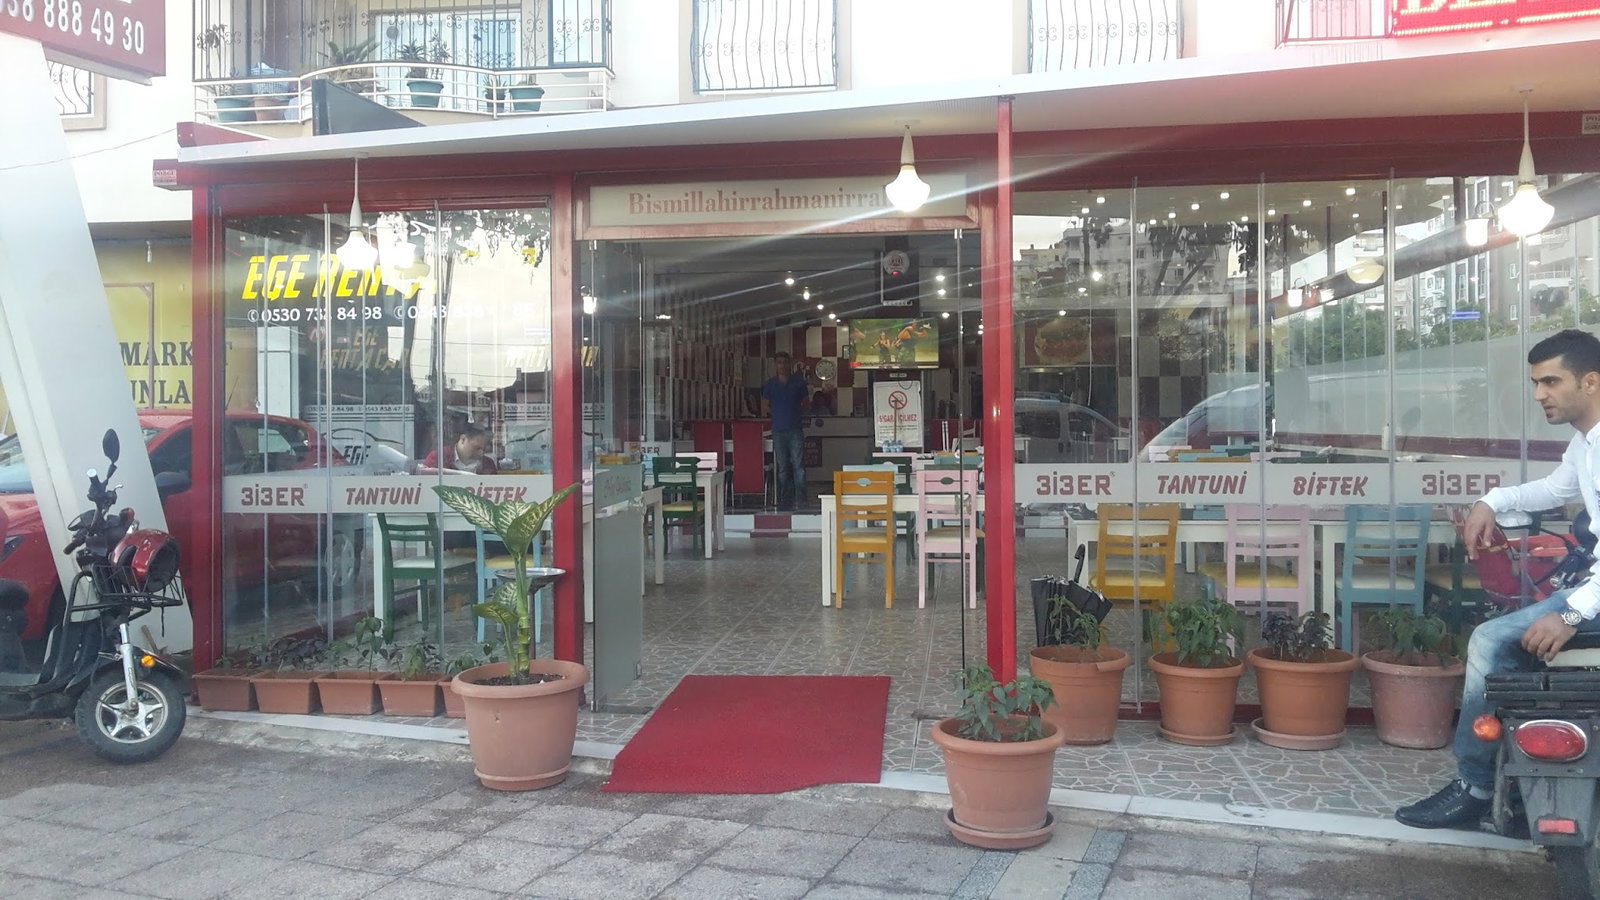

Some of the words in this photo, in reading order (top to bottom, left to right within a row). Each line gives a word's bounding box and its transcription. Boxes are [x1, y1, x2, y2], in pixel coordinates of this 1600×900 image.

[44, 0, 82, 36] 888
[91, 8, 114, 46] 49
[122, 17, 144, 54] 30
[241, 254, 310, 300] EGE
[262, 308, 301, 322] 0530
[337, 306, 357, 320] 84
[362, 306, 382, 320] 98
